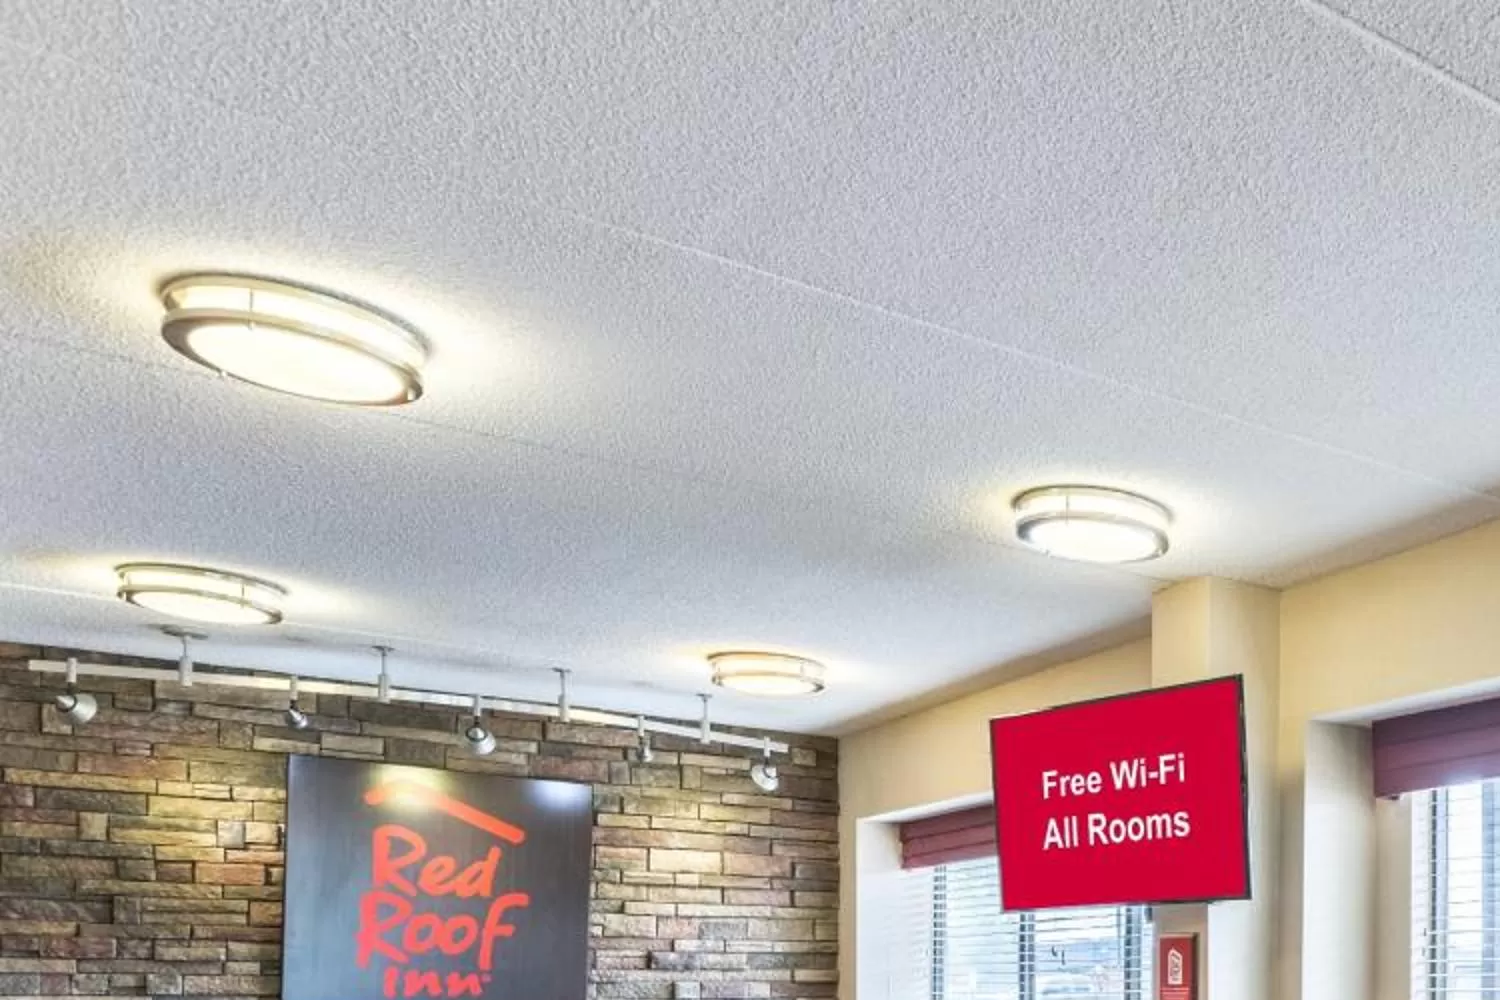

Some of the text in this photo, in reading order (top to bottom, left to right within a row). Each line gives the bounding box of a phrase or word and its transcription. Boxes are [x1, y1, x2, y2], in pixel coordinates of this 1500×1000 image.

[1042, 752, 1186, 800] Free Wi-Fi
[372, 823, 502, 897] Red
[1042, 811, 1191, 850] All Rooms
[354, 890, 530, 970] Roof
